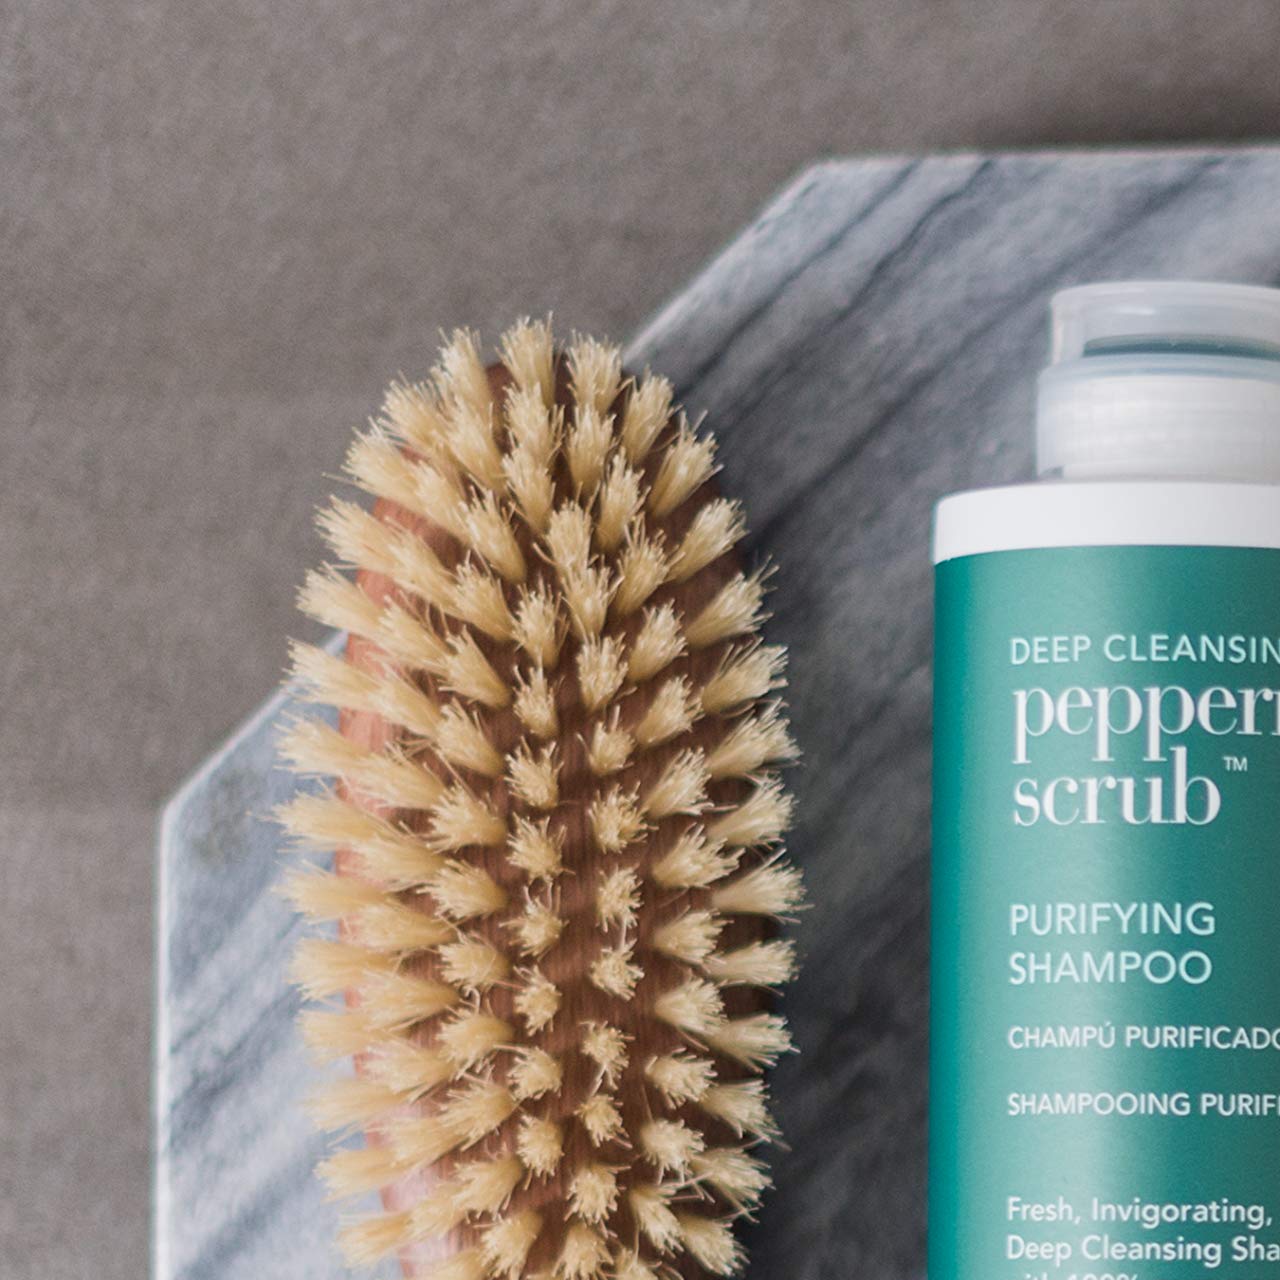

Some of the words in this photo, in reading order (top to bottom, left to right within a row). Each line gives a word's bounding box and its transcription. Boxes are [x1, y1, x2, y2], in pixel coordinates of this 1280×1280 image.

[1011, 635, 1091, 665] DEEP
[1010, 902, 1216, 936] PURIFYING
[1010, 950, 1213, 985] SHAMPOO
[1008, 1021, 1115, 1050] CHAMPÚ
[1008, 1091, 1191, 1117] SHAMPOOING
[1007, 1196, 1082, 1224] Fresh,
[1092, 1197, 1273, 1230] Invigorating,
[1007, 1235, 1072, 1267] Deep
[1082, 1235, 1222, 1269] Cleansing
